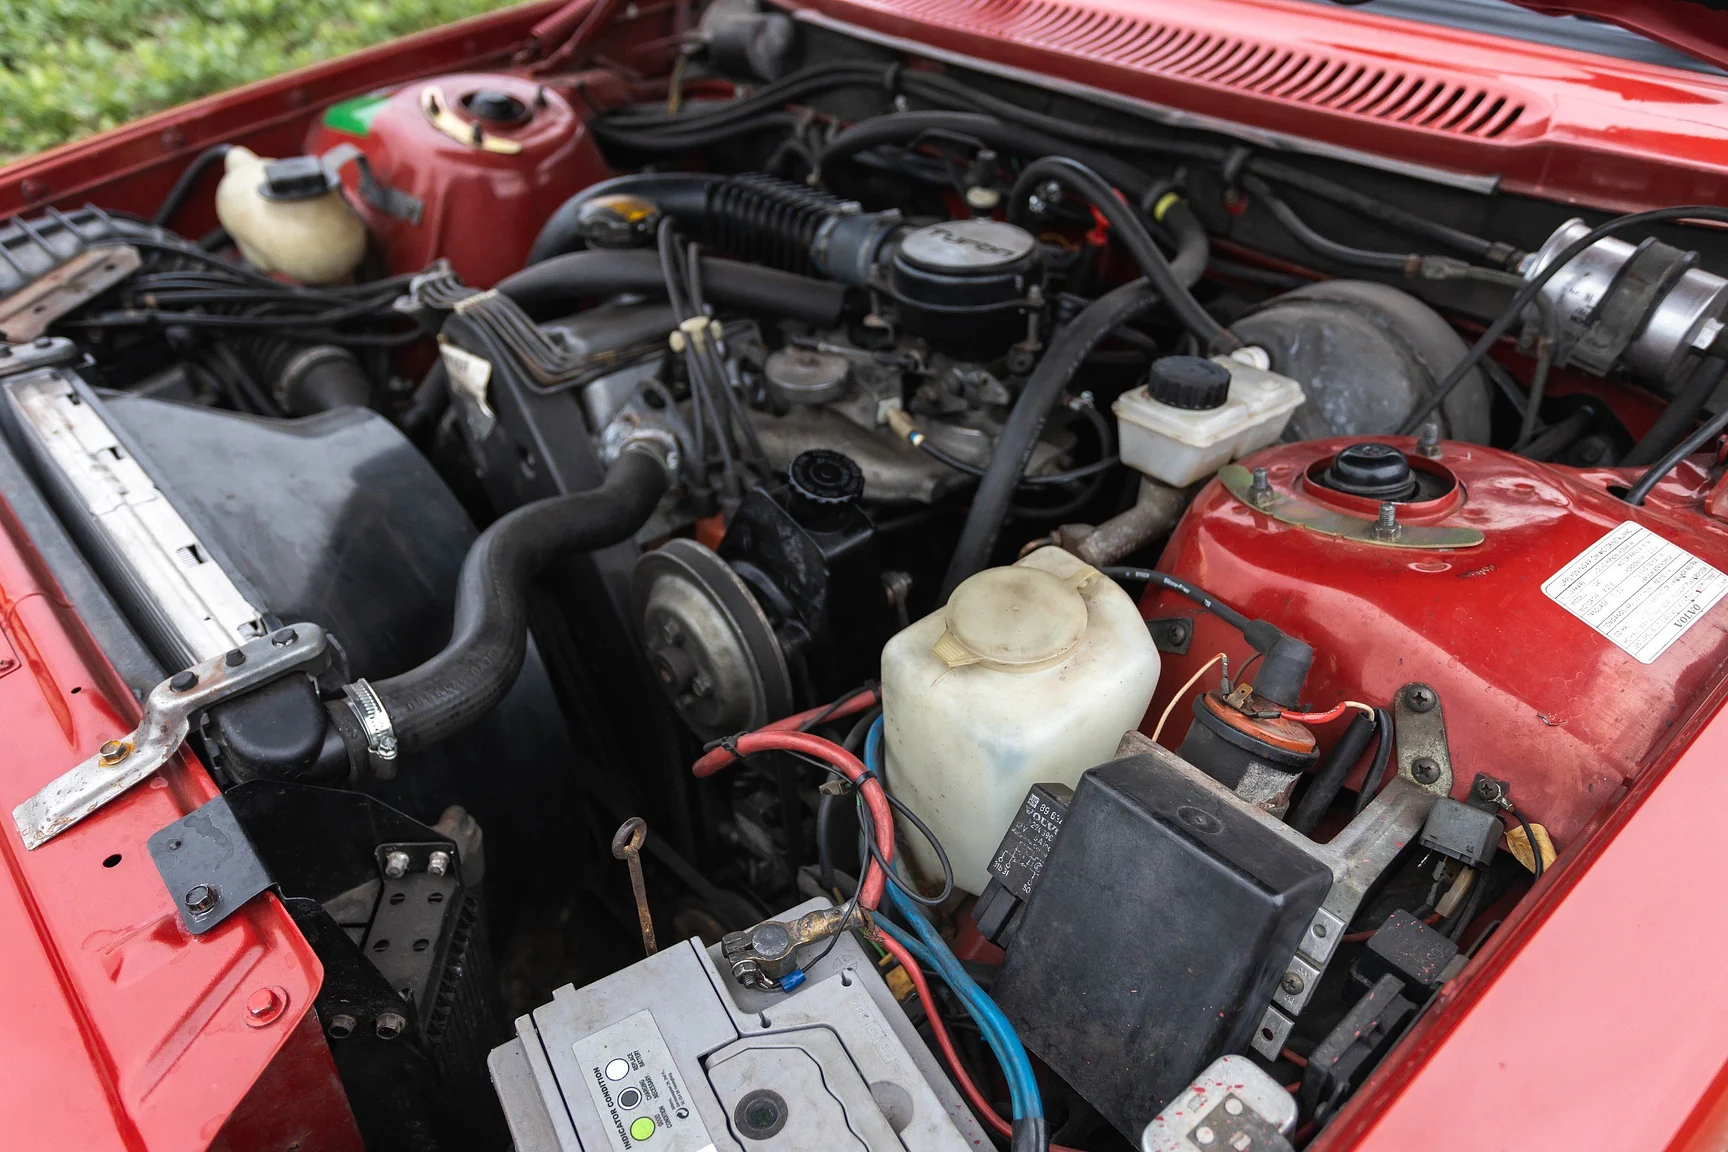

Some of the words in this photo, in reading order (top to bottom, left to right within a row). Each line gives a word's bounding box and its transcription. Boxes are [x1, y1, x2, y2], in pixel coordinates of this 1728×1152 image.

[1673, 602, 1702, 630] VOLVO
[1022, 883, 1032, 894] 50
[627, 1052, 639, 1071] REPLACE
[634, 1050, 645, 1067] BATTERY
[593, 1067, 614, 1108] CONDITION
[639, 1079, 652, 1101] CHARGING
[654, 1114, 664, 1127] GOOD
[659, 1105, 672, 1128] CONDITION
[610, 1108, 632, 1150] INDICATOR
